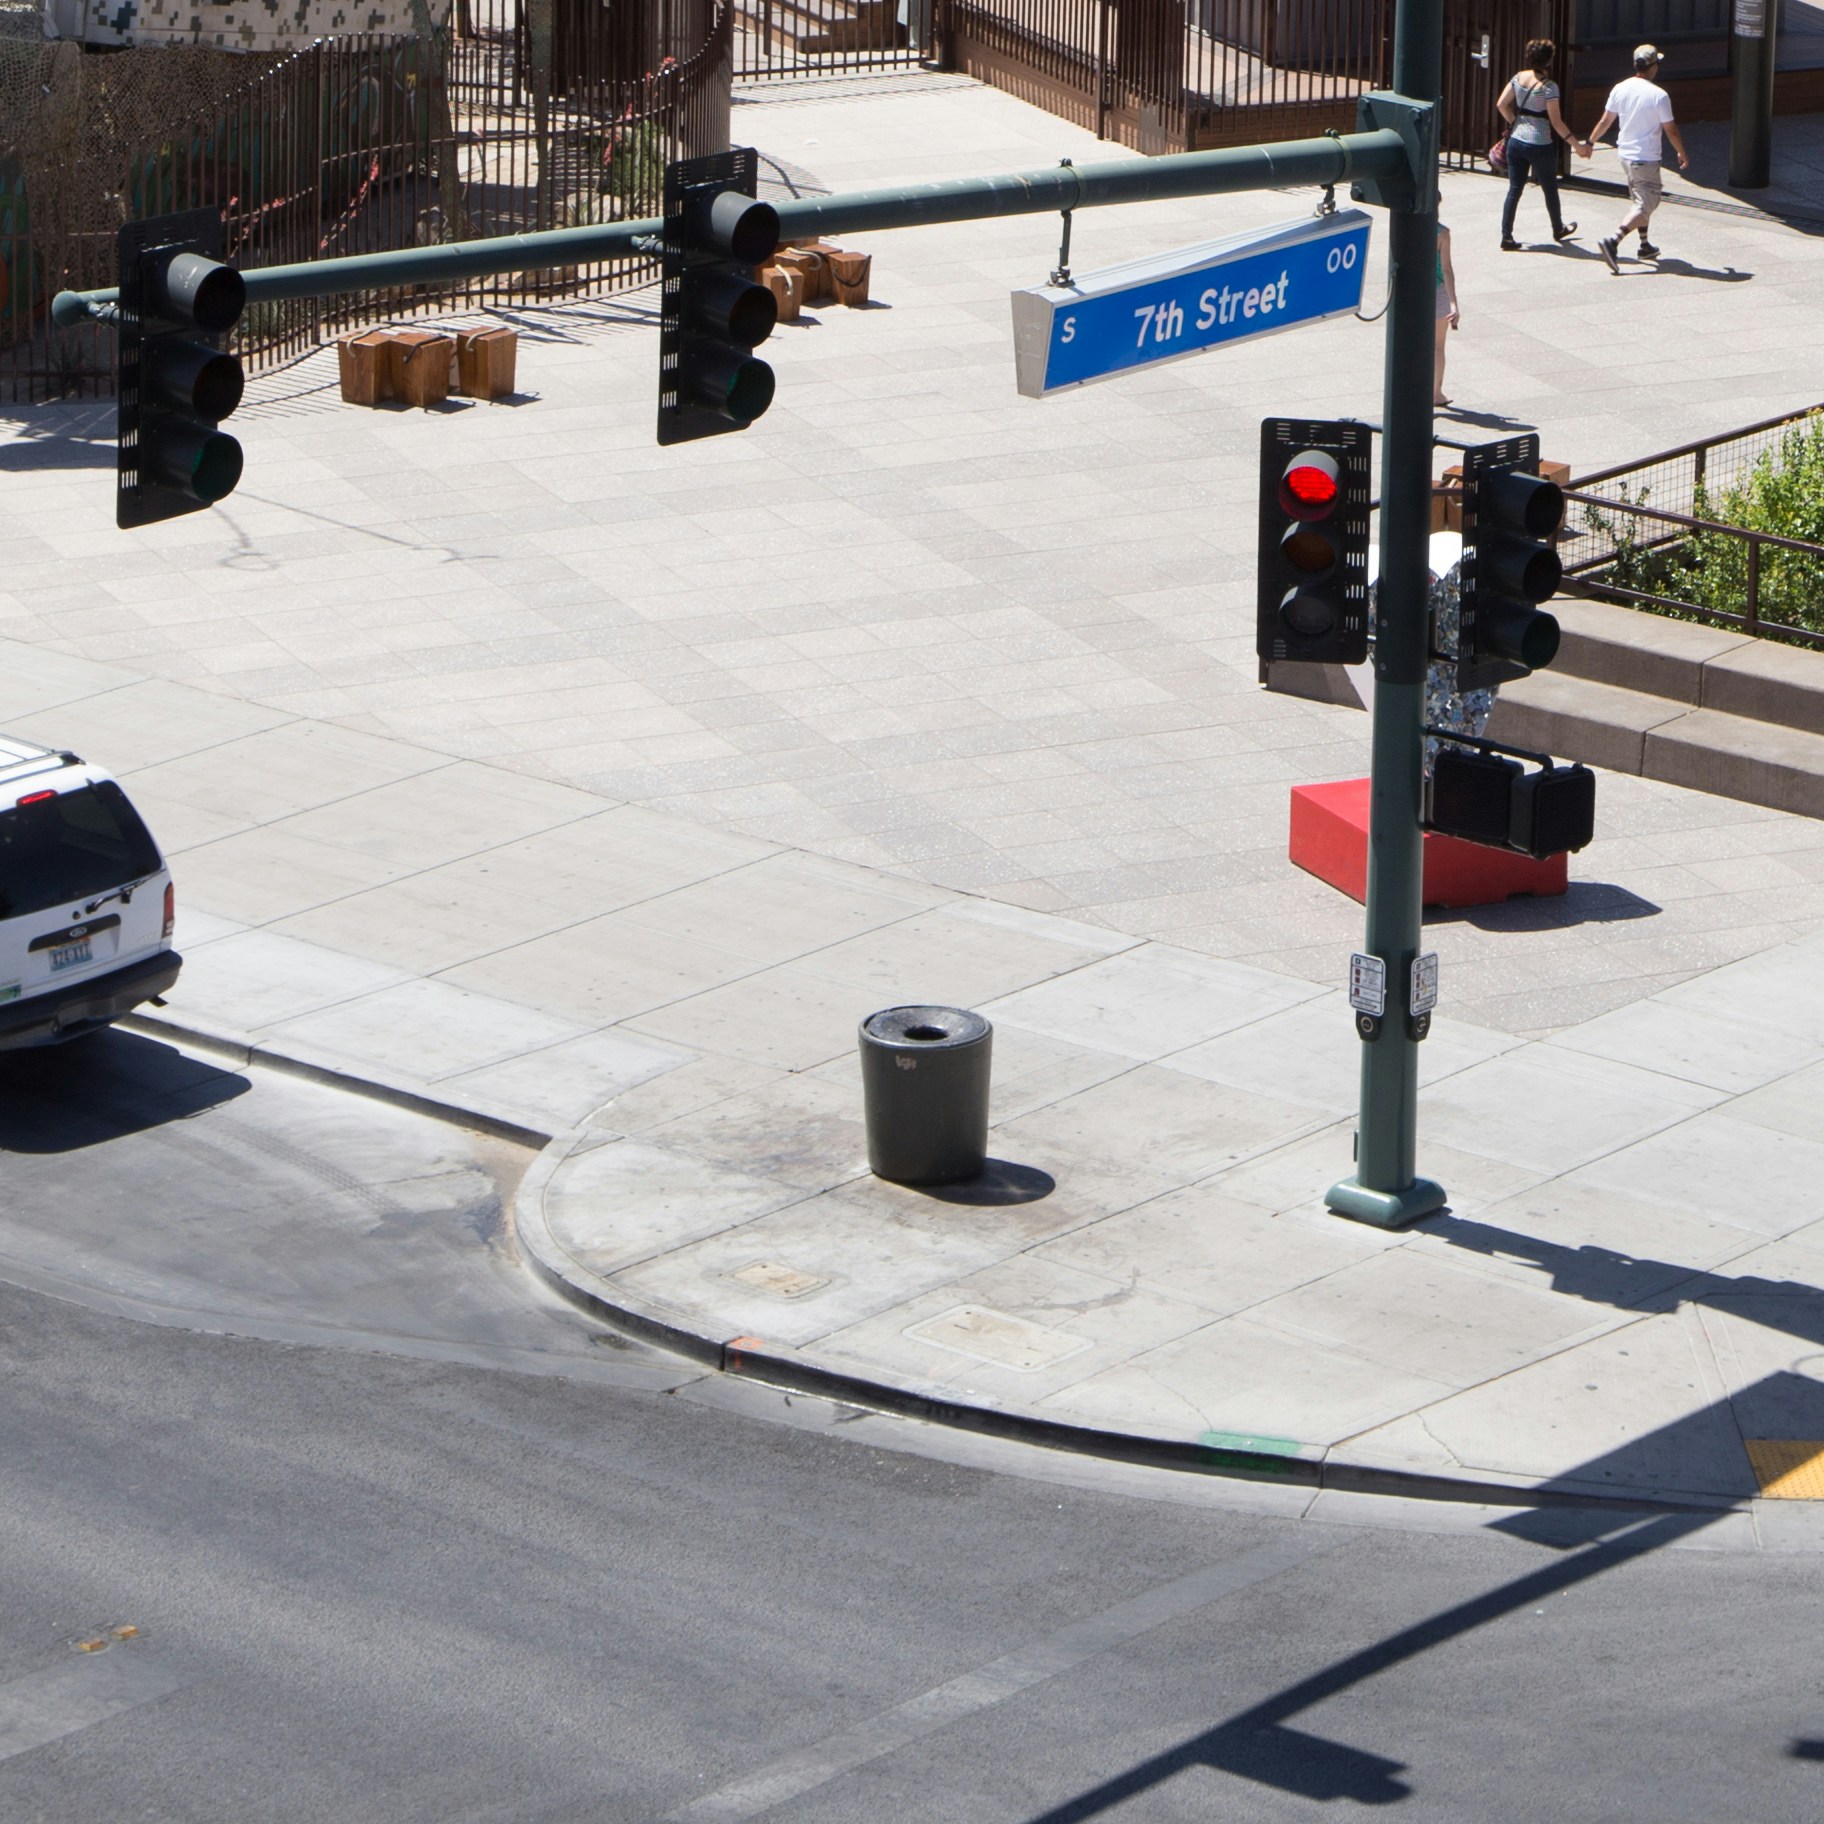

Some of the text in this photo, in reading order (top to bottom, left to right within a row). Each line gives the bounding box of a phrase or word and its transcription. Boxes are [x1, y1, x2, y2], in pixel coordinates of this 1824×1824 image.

[1061, 317, 1076, 344] S
[1133, 304, 1185, 348] 7th
[1195, 269, 1290, 331] Street
